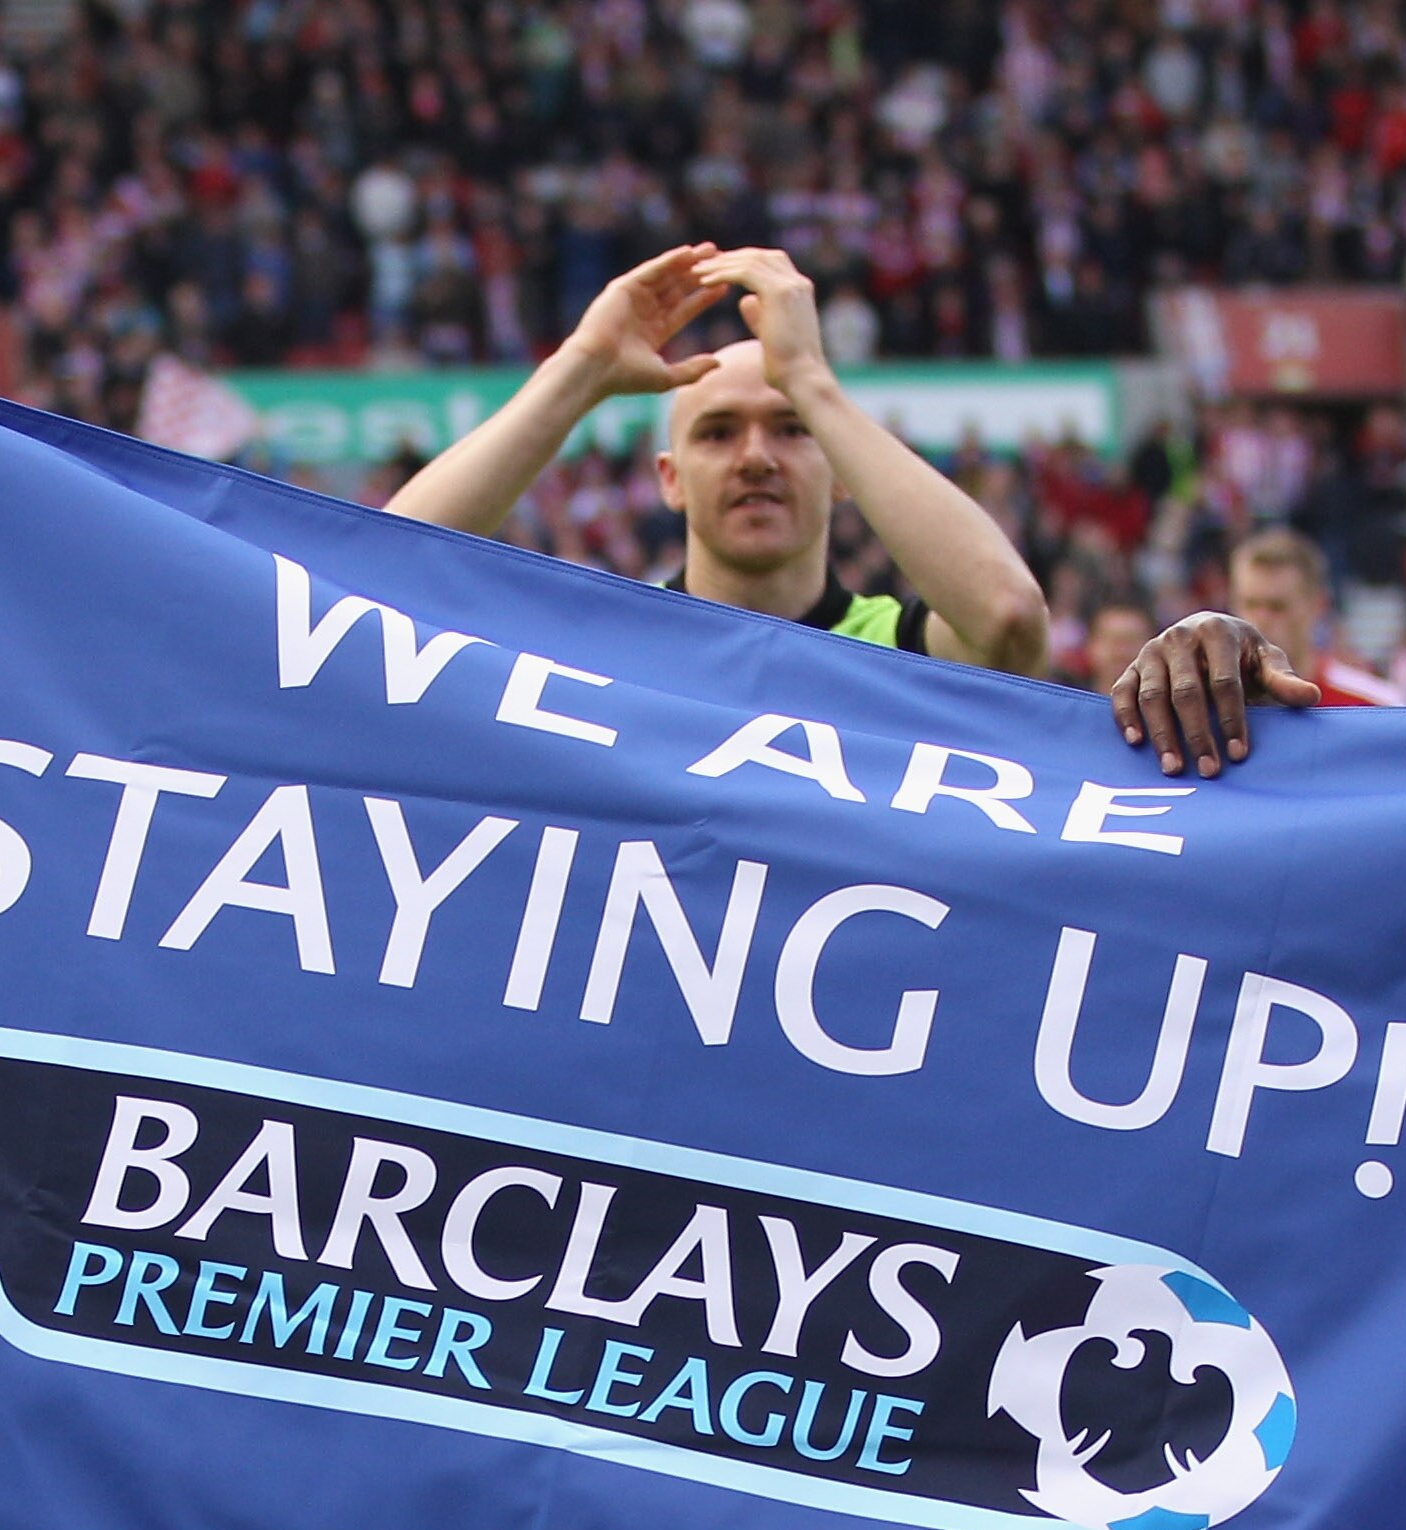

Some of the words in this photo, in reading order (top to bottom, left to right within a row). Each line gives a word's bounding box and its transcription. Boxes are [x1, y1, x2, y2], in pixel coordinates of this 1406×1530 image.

[272, 553, 619, 747] WE
[685, 713, 1197, 855] ARE
[53, 1241, 493, 1389] PREMIER
[522, 1329, 927, 1476] LEAGUE
[79, 1095, 962, 1377] BARCLAYS
